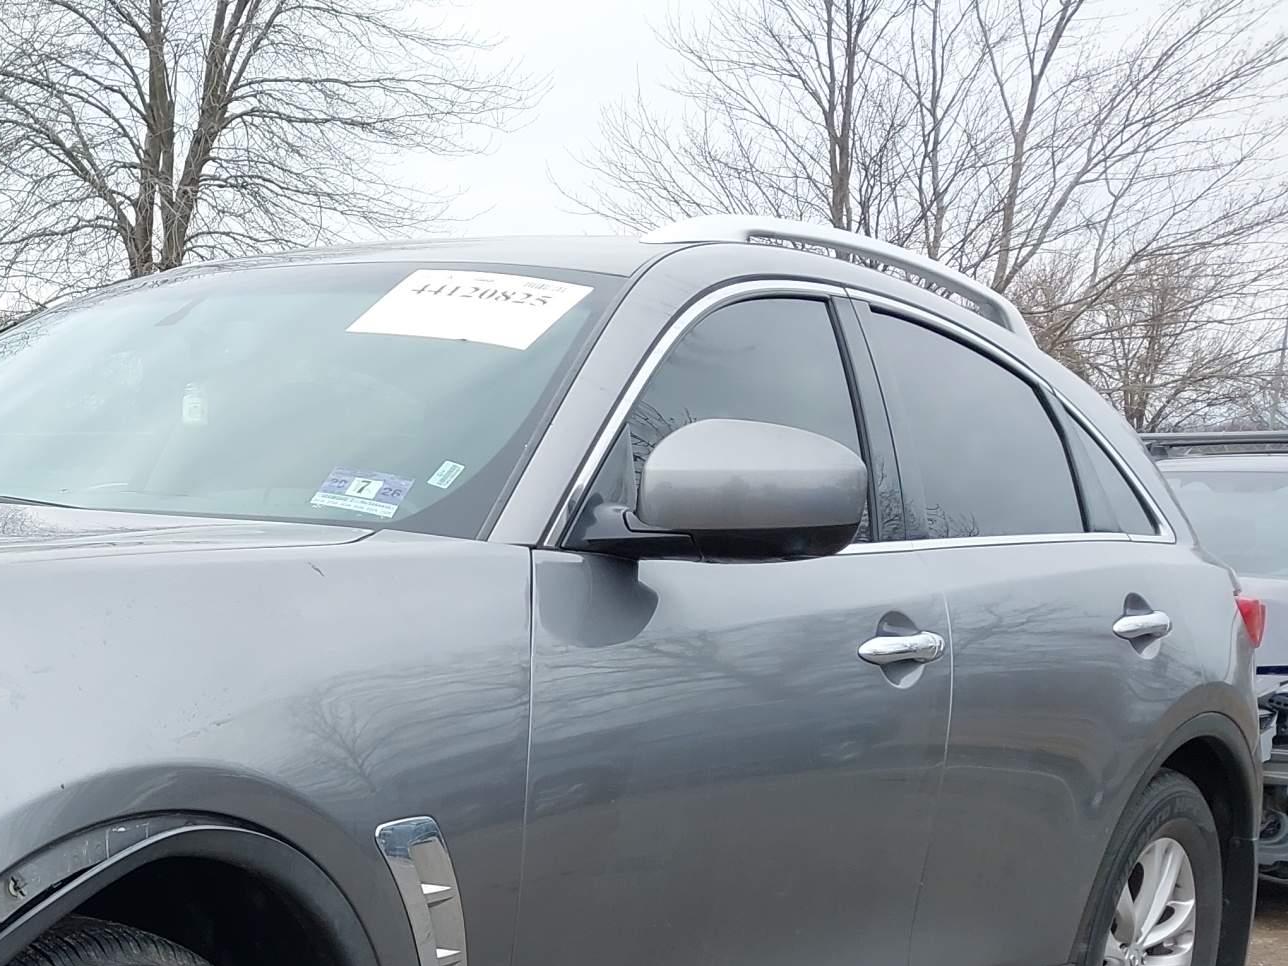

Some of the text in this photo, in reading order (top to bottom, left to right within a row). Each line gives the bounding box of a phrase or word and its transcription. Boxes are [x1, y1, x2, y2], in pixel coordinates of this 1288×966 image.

[412, 283, 553, 306] 44120825
[357, 480, 370, 494] 7
[381, 487, 403, 498] 26
